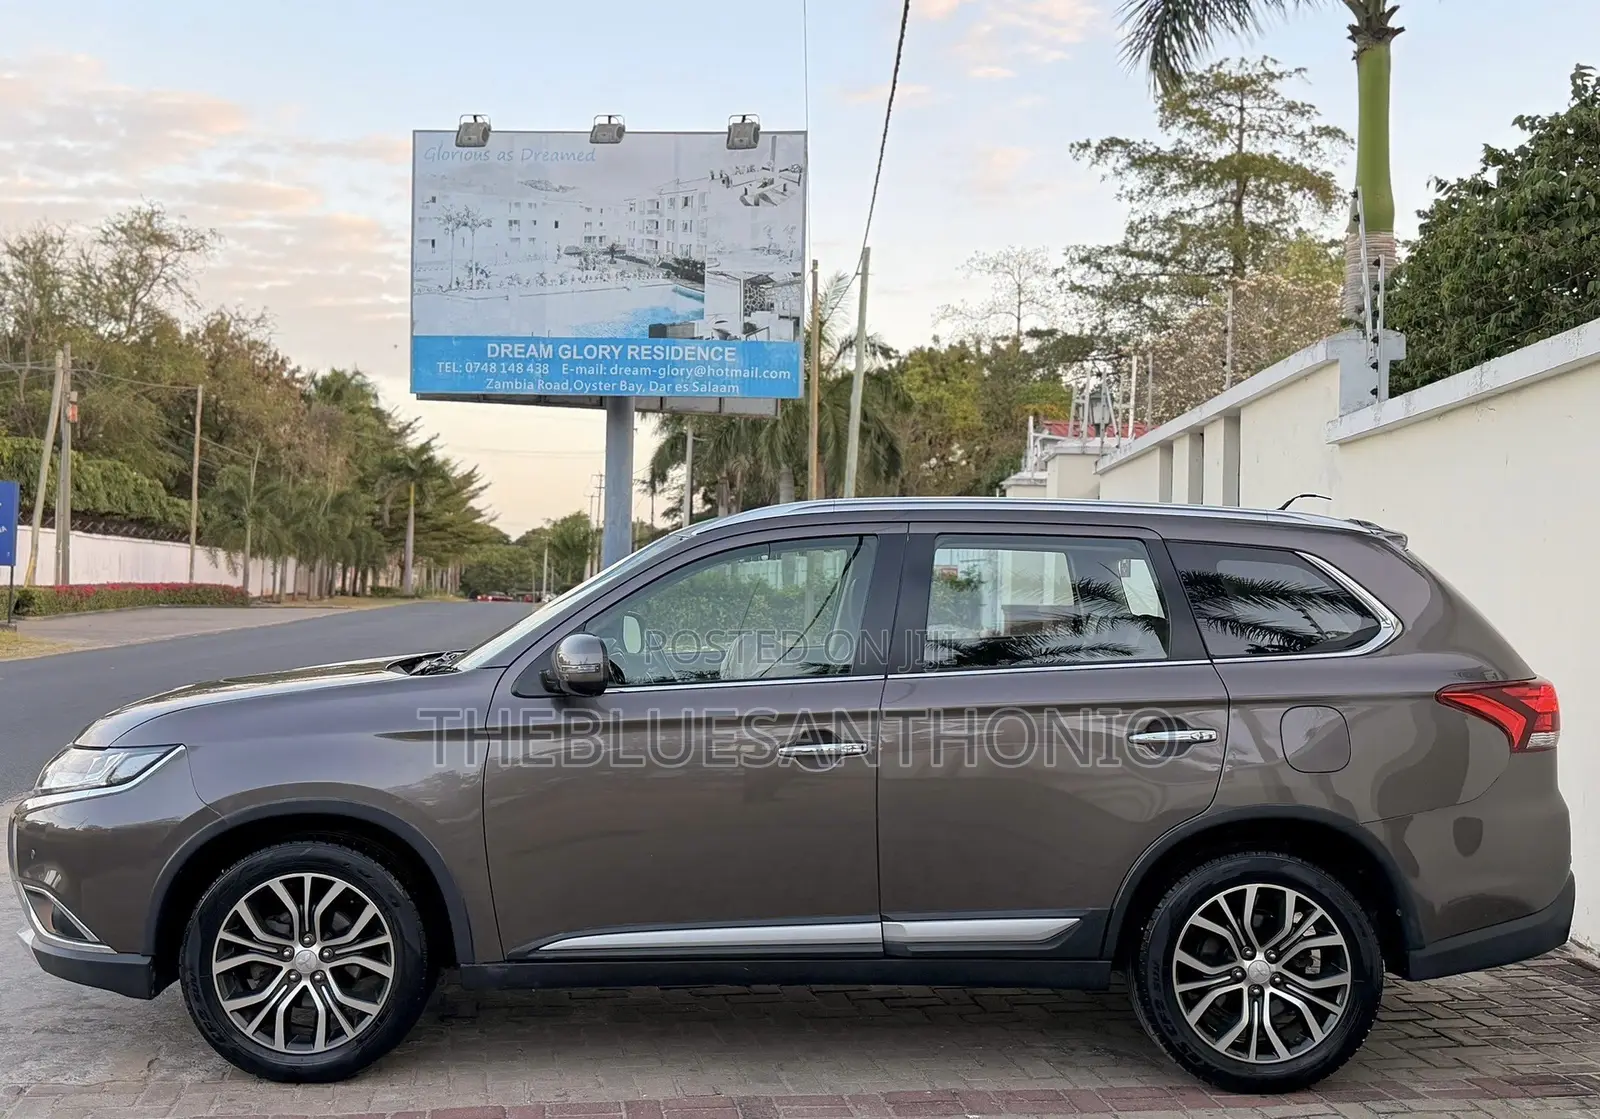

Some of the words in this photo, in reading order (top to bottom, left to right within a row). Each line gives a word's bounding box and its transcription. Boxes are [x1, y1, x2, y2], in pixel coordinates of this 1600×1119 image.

[424, 141, 490, 162] Glorious
[496, 150, 513, 162] as
[521, 147, 597, 162] Dreamed
[487, 343, 553, 359] DREAM
[558, 344, 624, 360] GLORY
[627, 345, 737, 362] RESIDENCE
[436, 361, 462, 373] TEL:
[465, 361, 497, 374] 0748
[500, 362, 524, 374] 148
[526, 362, 549, 374] 438
[562, 363, 607, 376] E-mail:
[609, 364, 791, 380] dream-glory@hotmail.com
[485, 378, 534, 390] Zambia
[620, 381, 645, 395] Bay,
[649, 382, 671, 393] Dar
[675, 383, 689, 393] es
[692, 381, 740, 394] Salaam
